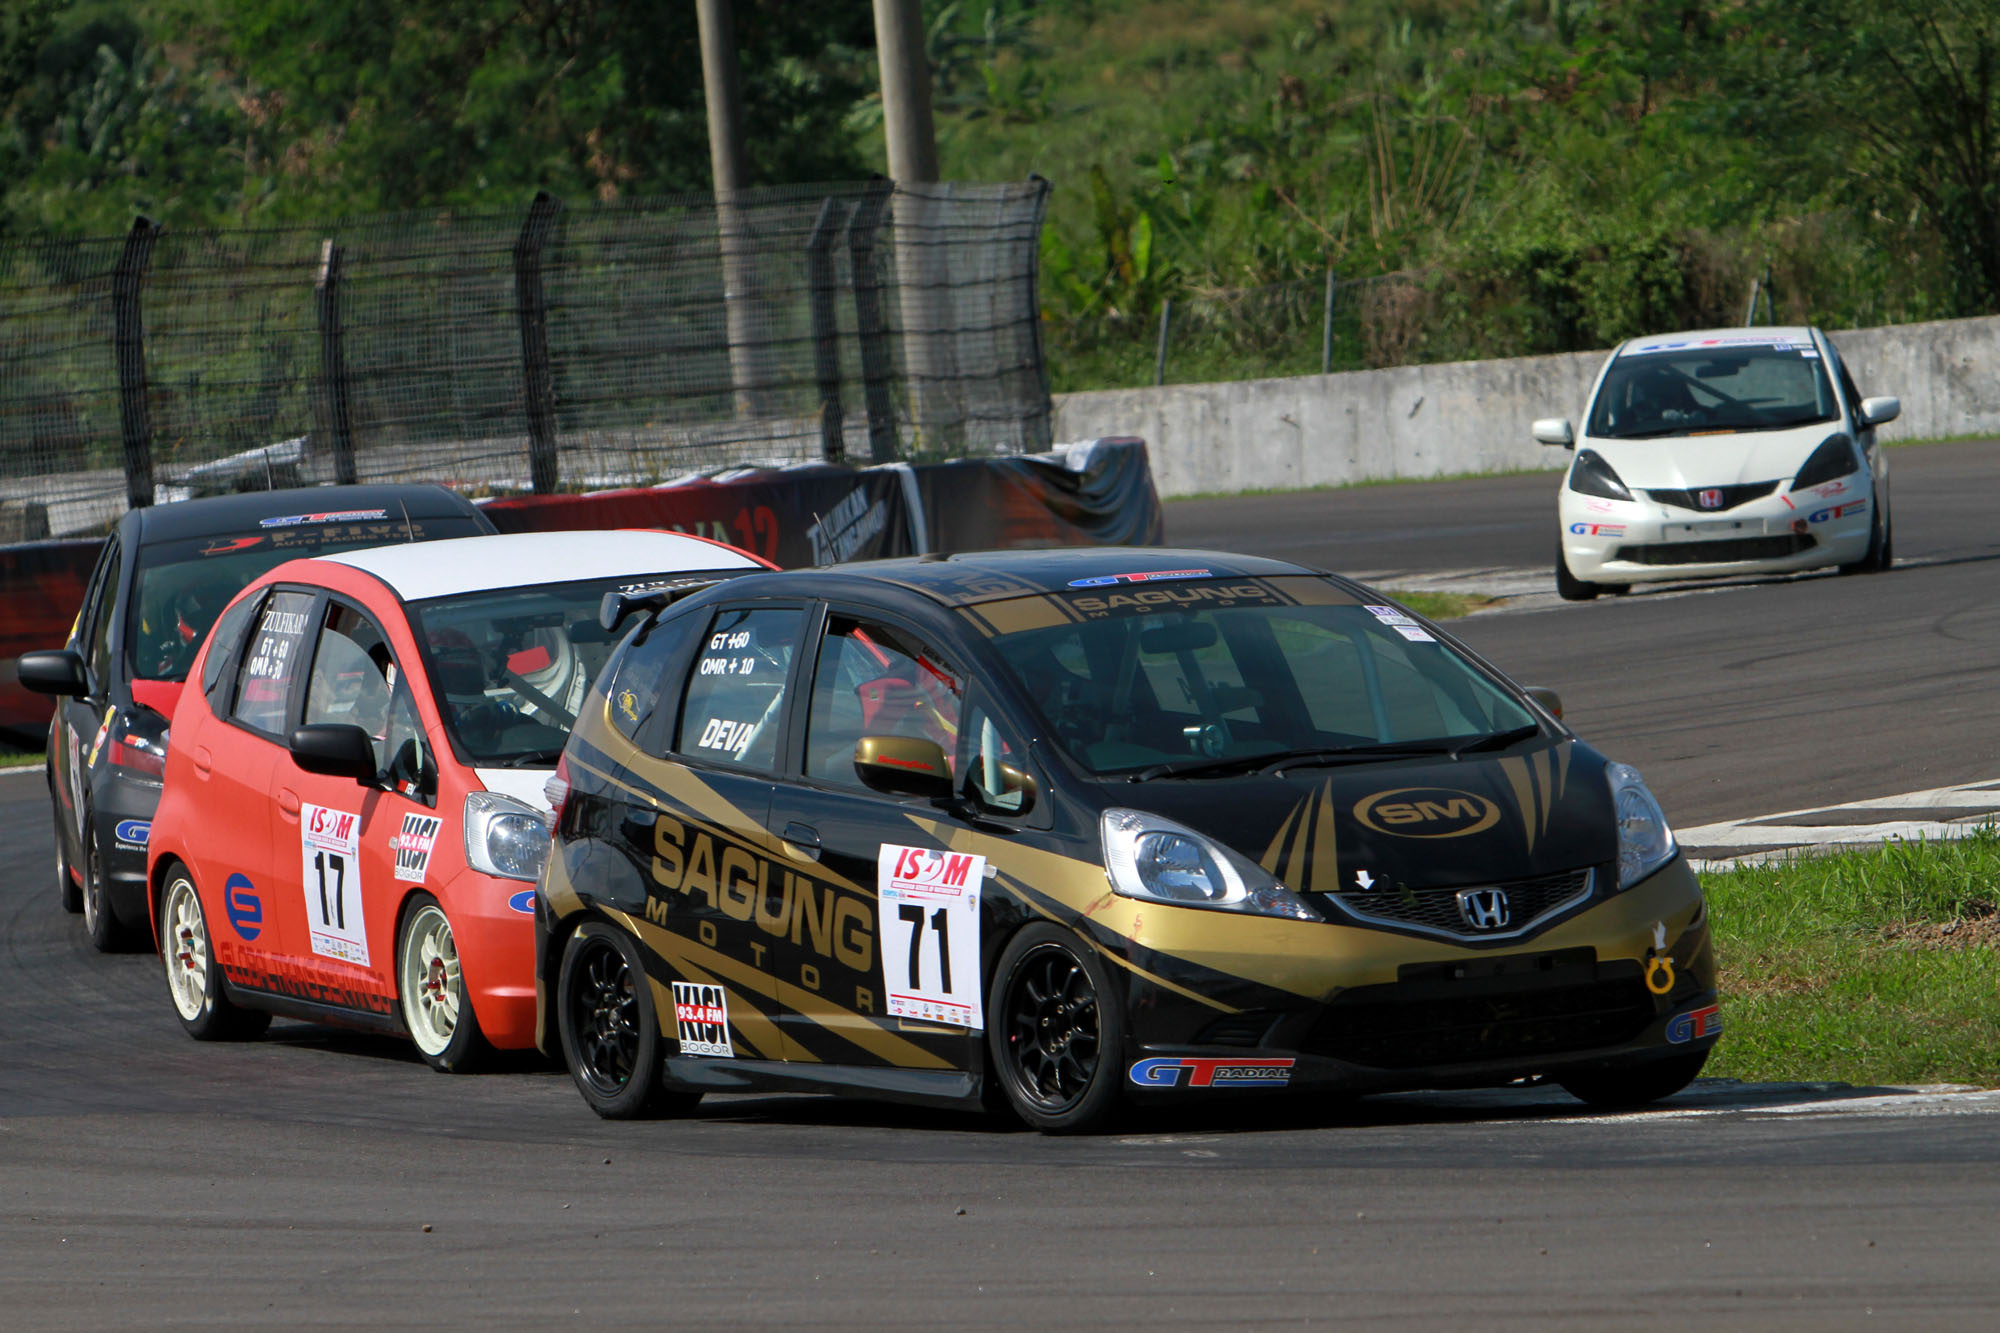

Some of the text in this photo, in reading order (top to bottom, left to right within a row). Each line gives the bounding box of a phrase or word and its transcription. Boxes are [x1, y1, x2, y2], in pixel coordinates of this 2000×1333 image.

[1072, 585, 1268, 611] SAGUNG
[1088, 597, 1278, 618] MOTOR
[711, 633, 729, 650] GT
[250, 656, 269, 676] OMR
[700, 658, 727, 675] OMR
[738, 658, 755, 675] 10
[698, 718, 756, 753] DEVA
[1375, 798, 1481, 825] SM
[399, 833, 432, 851] 93.4 FM
[394, 867, 423, 881] BOGOR
[314, 850, 345, 930] 17
[651, 814, 873, 973] SAGUNG
[645, 895, 874, 1013] MOTOR
[898, 903, 952, 995] 71
[678, 1005, 724, 1023] 93.4 FM
[1665, 1004, 1721, 1044] GT
[681, 1042, 730, 1055] BOGOR
[1214, 1068, 1293, 1079] RADIAL
